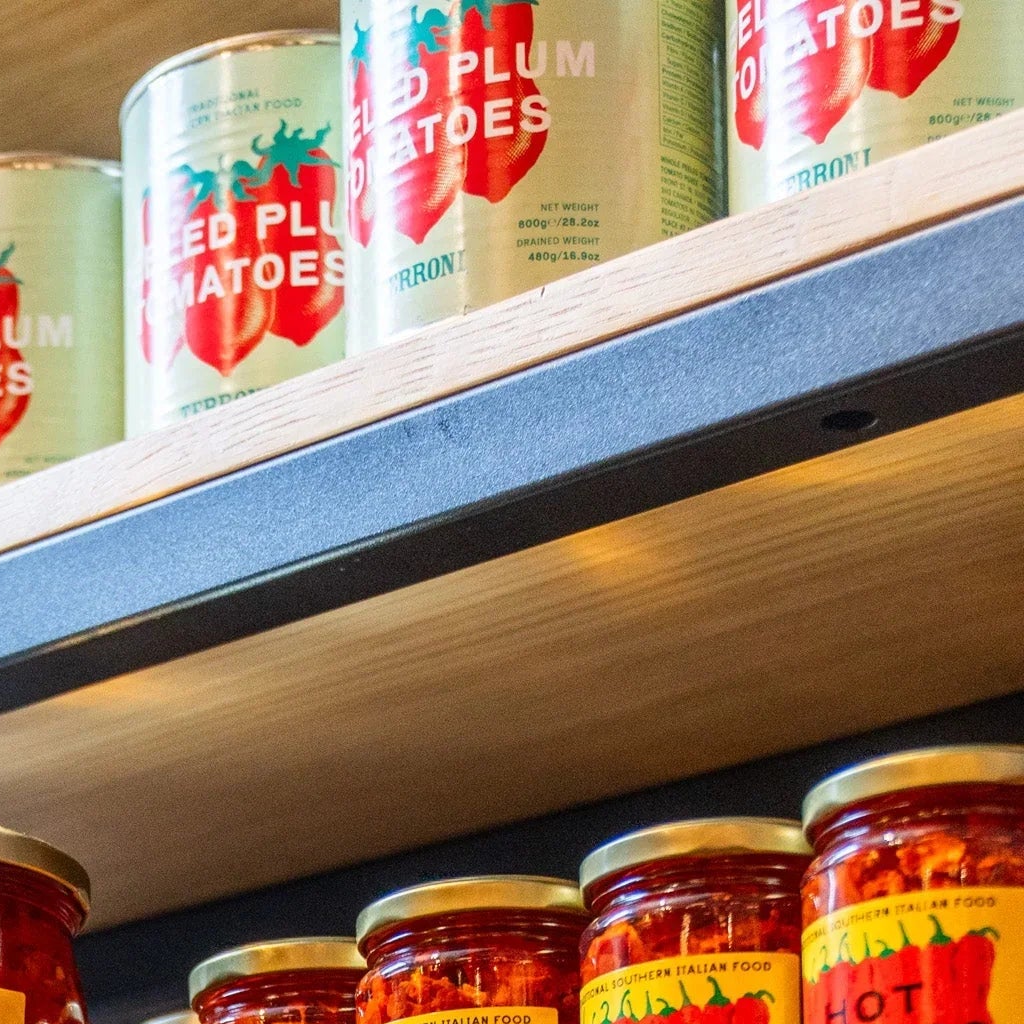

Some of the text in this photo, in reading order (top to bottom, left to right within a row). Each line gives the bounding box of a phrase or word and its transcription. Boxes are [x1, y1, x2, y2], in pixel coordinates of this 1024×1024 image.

[448, 40, 596, 93] PLUM
[256, 201, 346, 241] PLU
[541, 203, 600, 212] NET WEIGHT
[517, 236, 600, 248] DRAINED WEIGHT
[174, 250, 346, 309] MATOES
[612, 968, 671, 990] SOUTHERN
[676, 963, 726, 977] ITALIAN
[732, 961, 772, 972] FOOD
